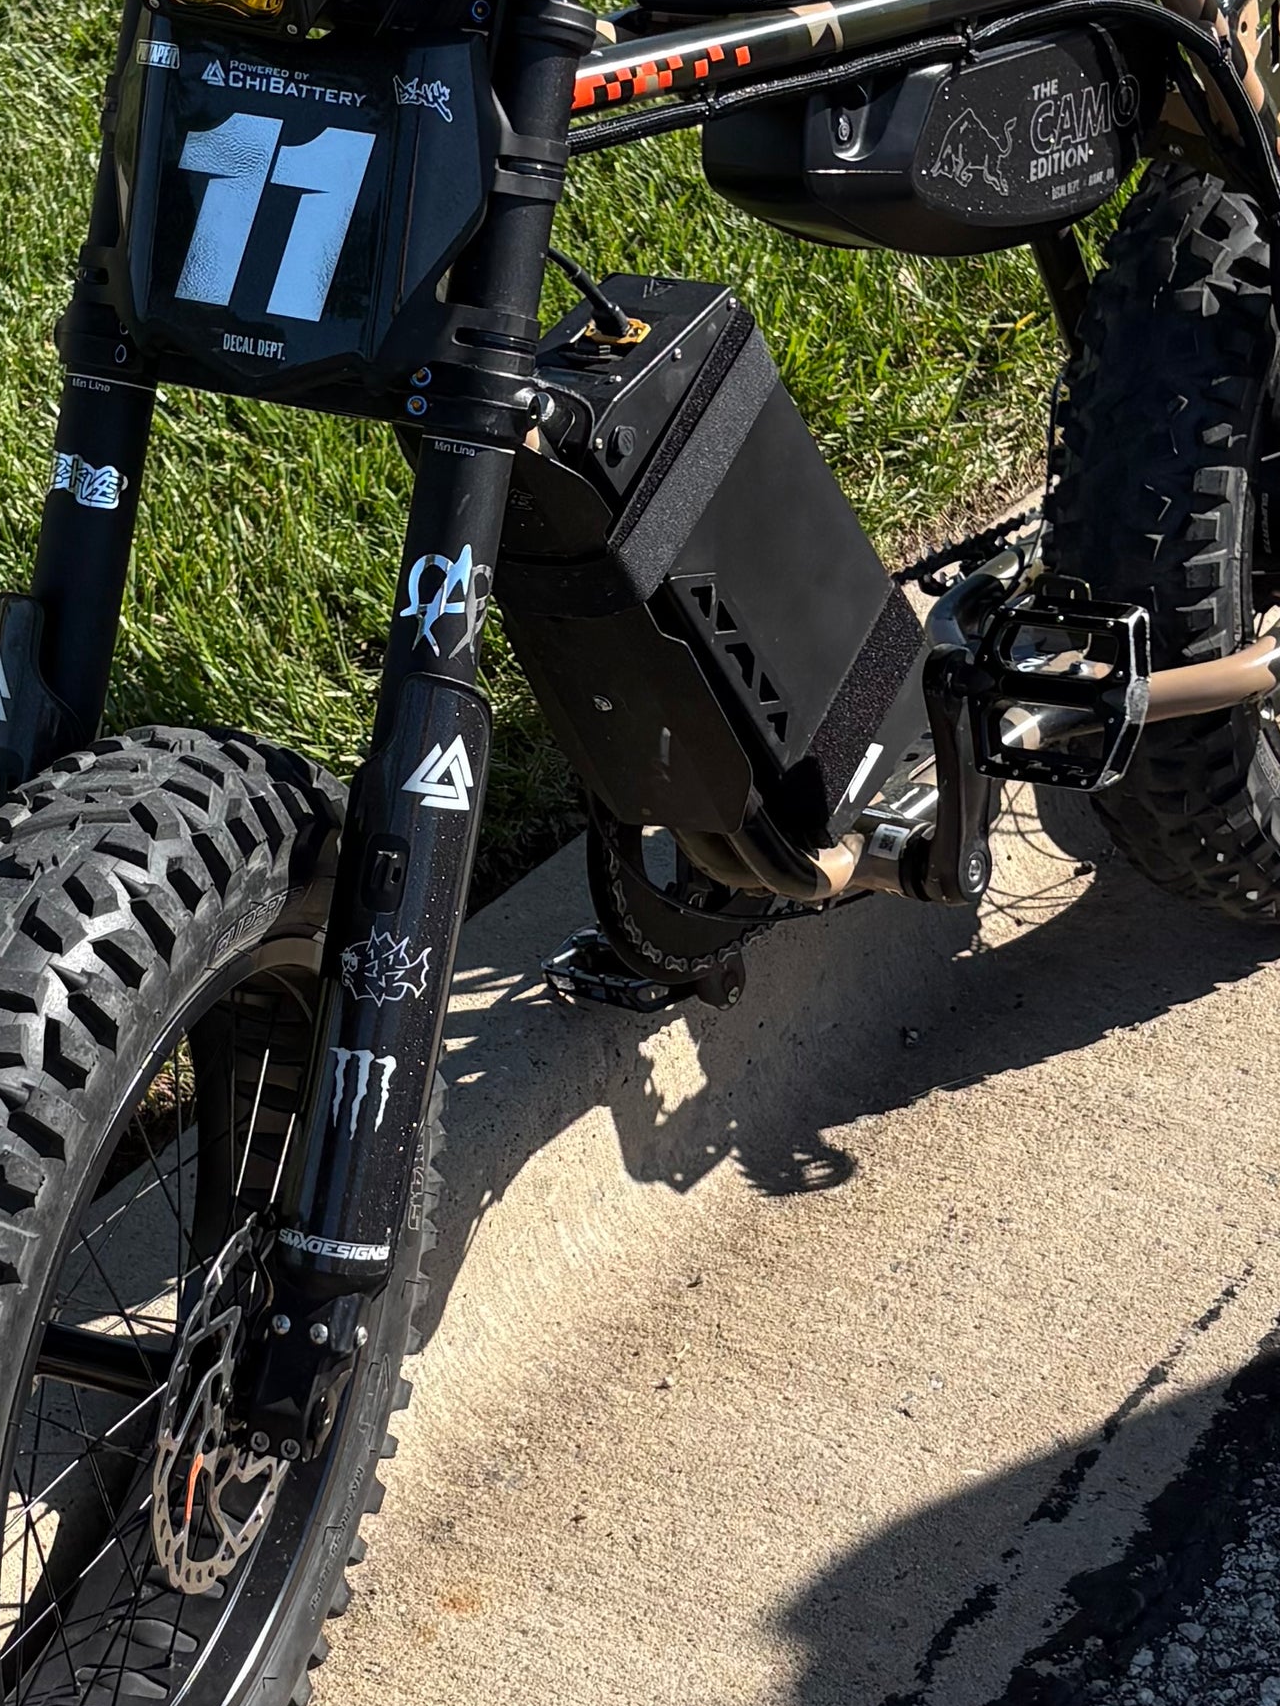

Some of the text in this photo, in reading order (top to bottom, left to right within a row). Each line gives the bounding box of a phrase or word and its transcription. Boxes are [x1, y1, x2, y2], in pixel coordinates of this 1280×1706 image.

[1032, 78, 1059, 101] THE
[1030, 74, 1141, 155] CAMO
[1029, 142, 1090, 183] EDITION
[174, 112, 376, 323] 11
[222, 333, 286, 361] DECAL DEPT.
